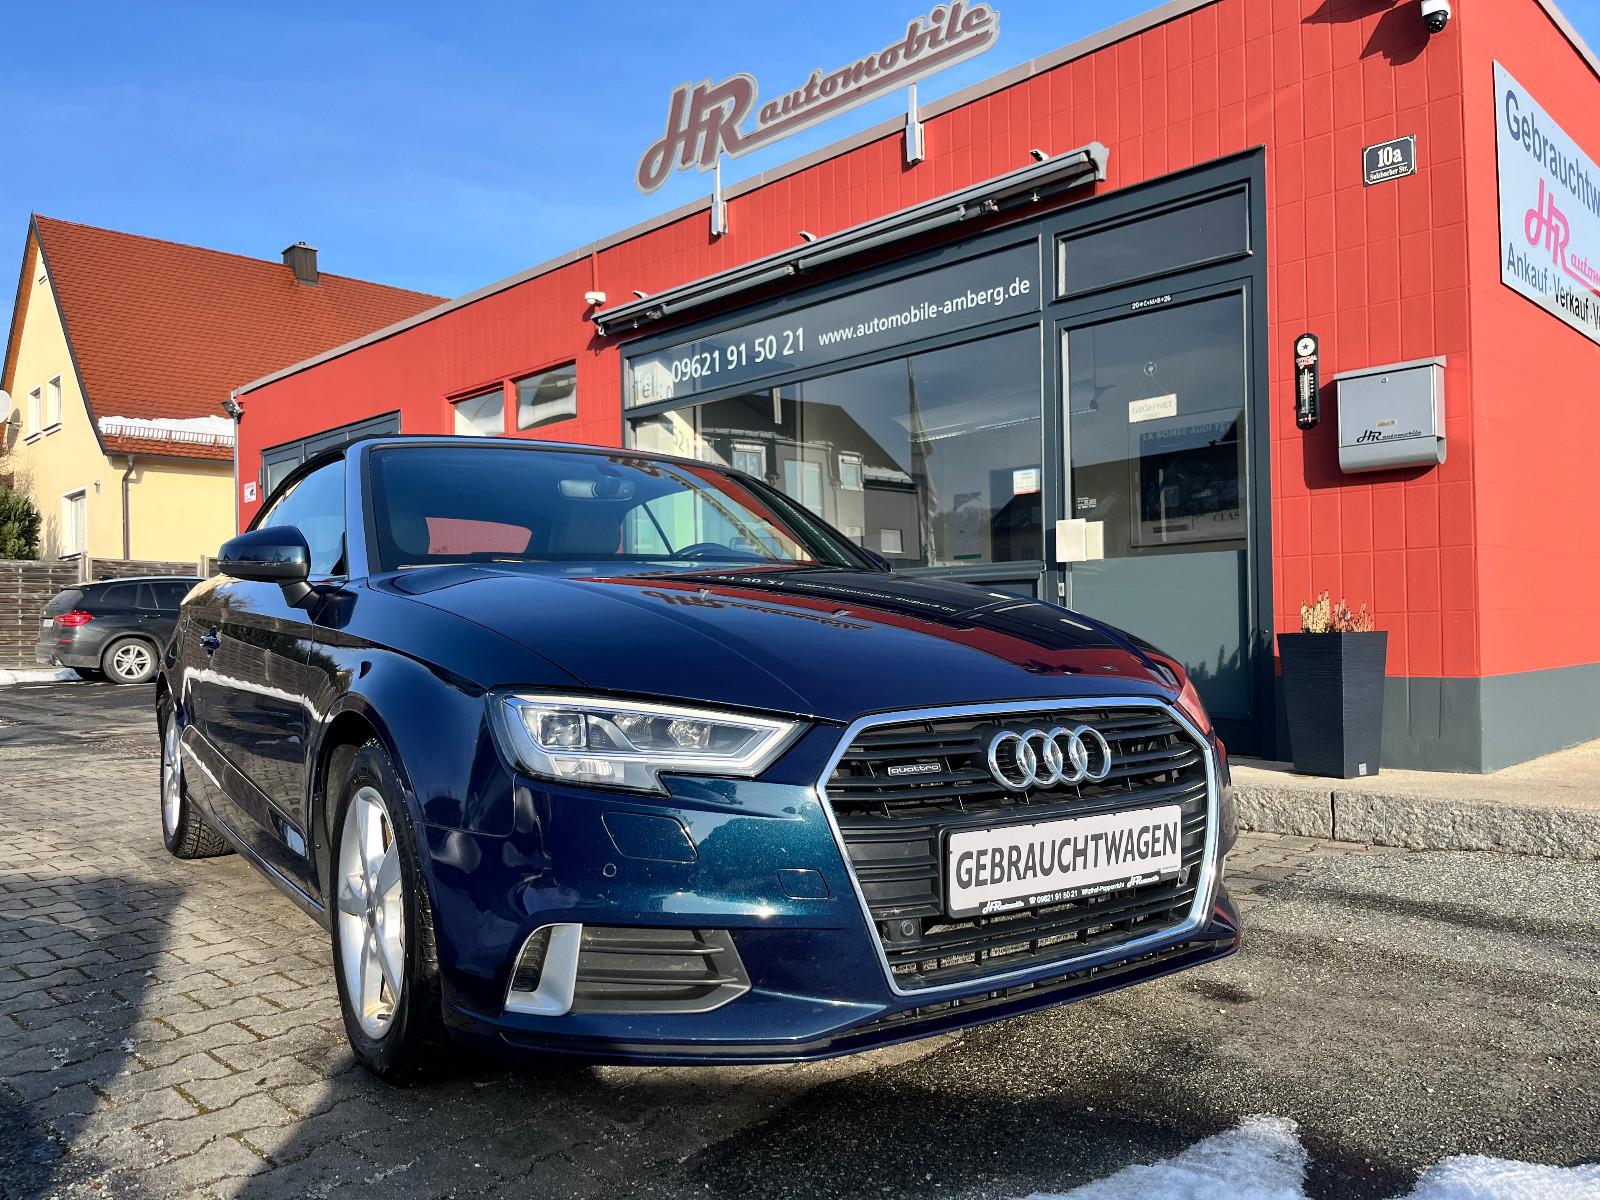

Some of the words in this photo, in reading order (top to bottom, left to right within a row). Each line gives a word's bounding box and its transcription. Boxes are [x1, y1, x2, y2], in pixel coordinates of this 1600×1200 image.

[636, 73, 758, 193] HR
[758, 0, 996, 127] automobile
[1369, 168, 1399, 181] Sulzbacher
[1398, 165, 1409, 174] Str.
[1377, 146, 1403, 168] 10a
[1524, 176, 1570, 266] HR
[1507, 242, 1548, 296] Ankauf
[1553, 273, 1589, 323] Verkauf
[671, 349, 720, 383] 09621
[727, 342, 746, 370] 91
[754, 335, 777, 363] 50
[783, 326, 806, 357] 21
[818, 277, 1030, 346] www.automobile-amberg.de
[1357, 430, 1381, 443] HR
[890, 764, 940, 776] quattro
[955, 820, 1178, 890] GEBRAUCHTWAGEN
[1036, 894, 1054, 904] 09621
[1055, 892, 1062, 901] 91
[1063, 890, 1070, 899] 50
[1071, 889, 1078, 898] 21
